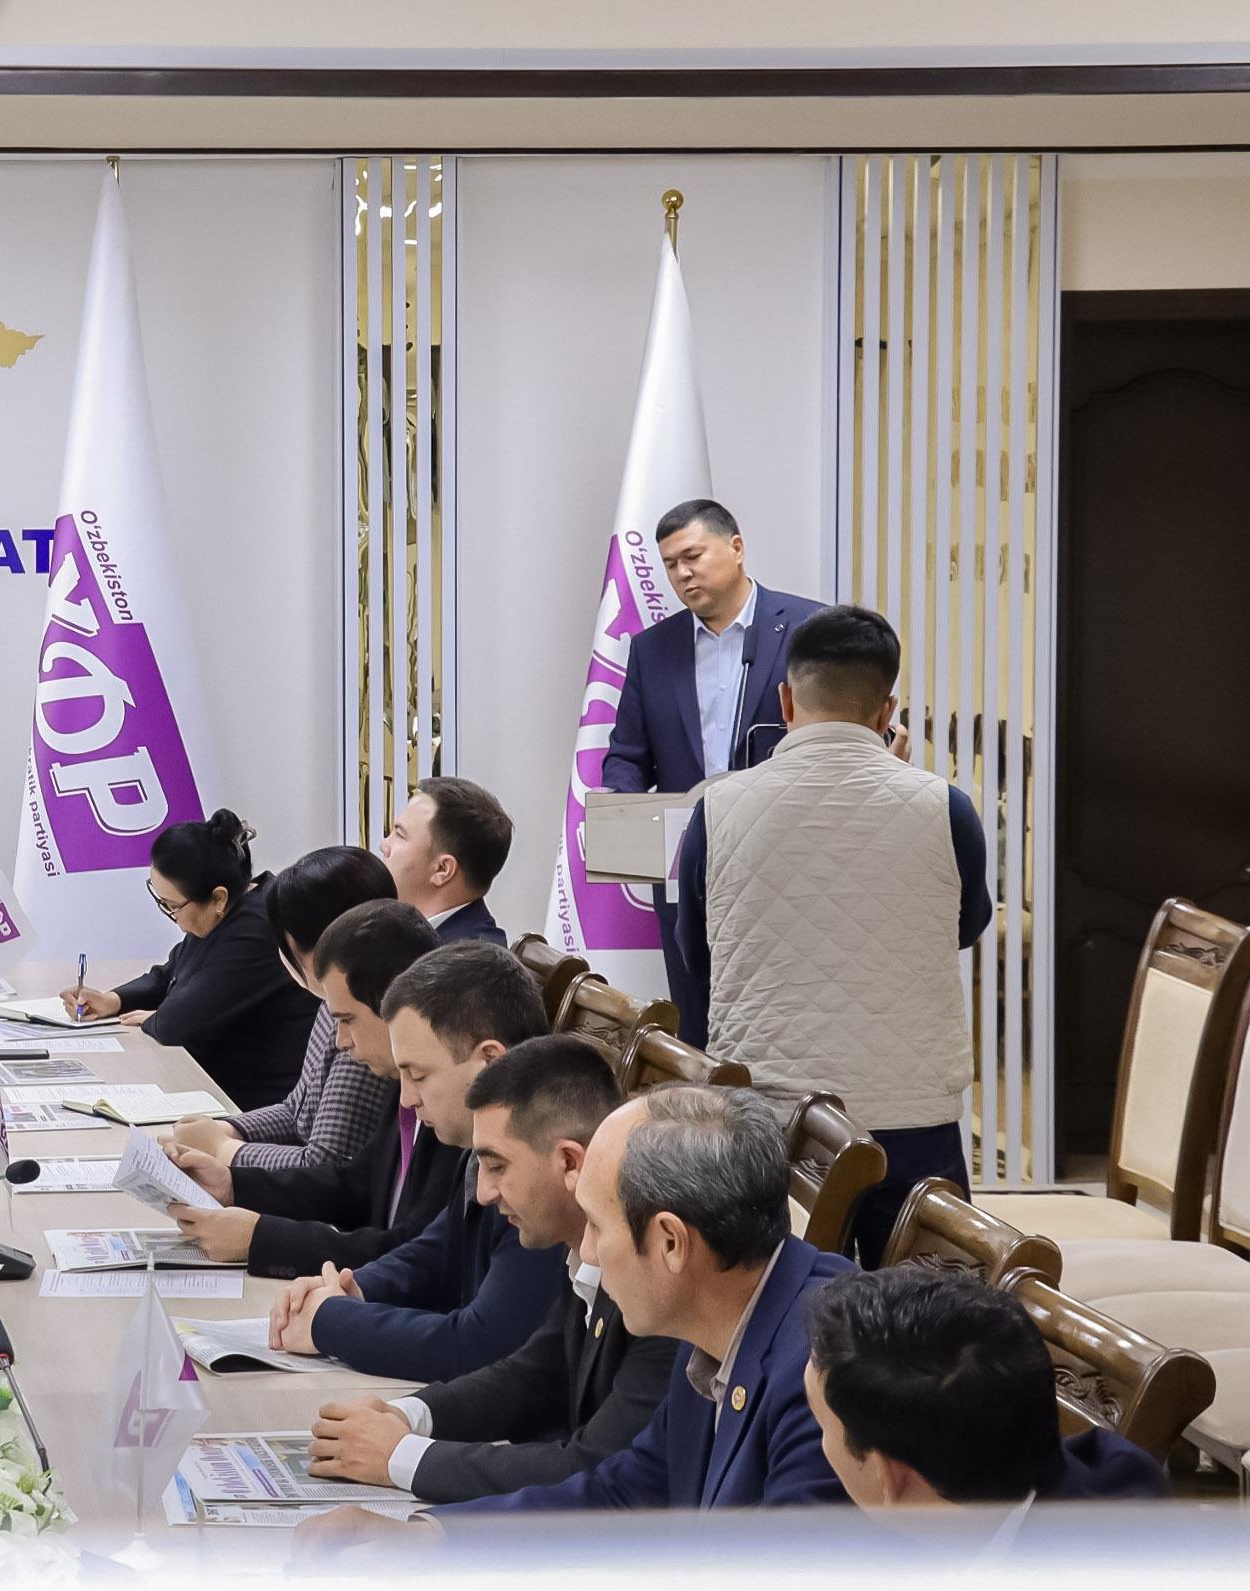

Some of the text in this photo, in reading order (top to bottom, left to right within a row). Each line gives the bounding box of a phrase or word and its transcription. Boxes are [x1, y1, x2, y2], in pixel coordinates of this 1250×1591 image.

[625, 530, 669, 623] O‘zbekis
[29, 800, 61, 877] partiyasi
[556, 863, 580, 953] partiyasi
